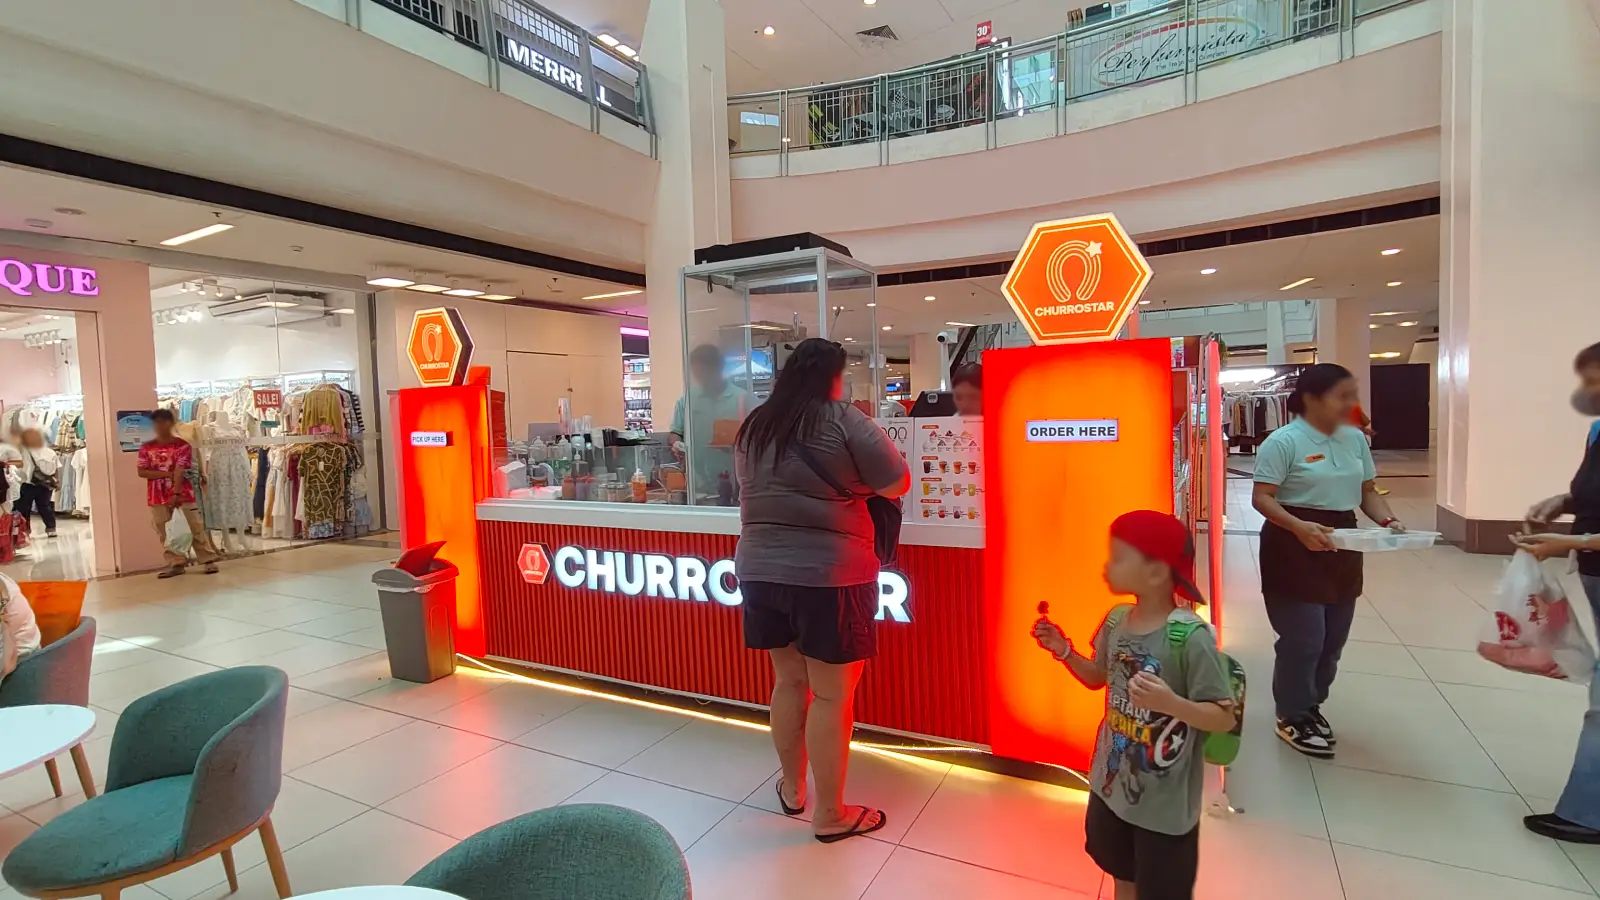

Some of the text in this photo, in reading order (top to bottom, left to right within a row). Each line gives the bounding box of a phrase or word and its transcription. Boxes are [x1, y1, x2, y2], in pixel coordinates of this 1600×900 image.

[507, 38, 612, 107] MERREL
[1034, 301, 1115, 317] CHURROSTAR
[256, 393, 279, 405] SALE!
[1030, 426, 1116, 437] ORDER HERE
